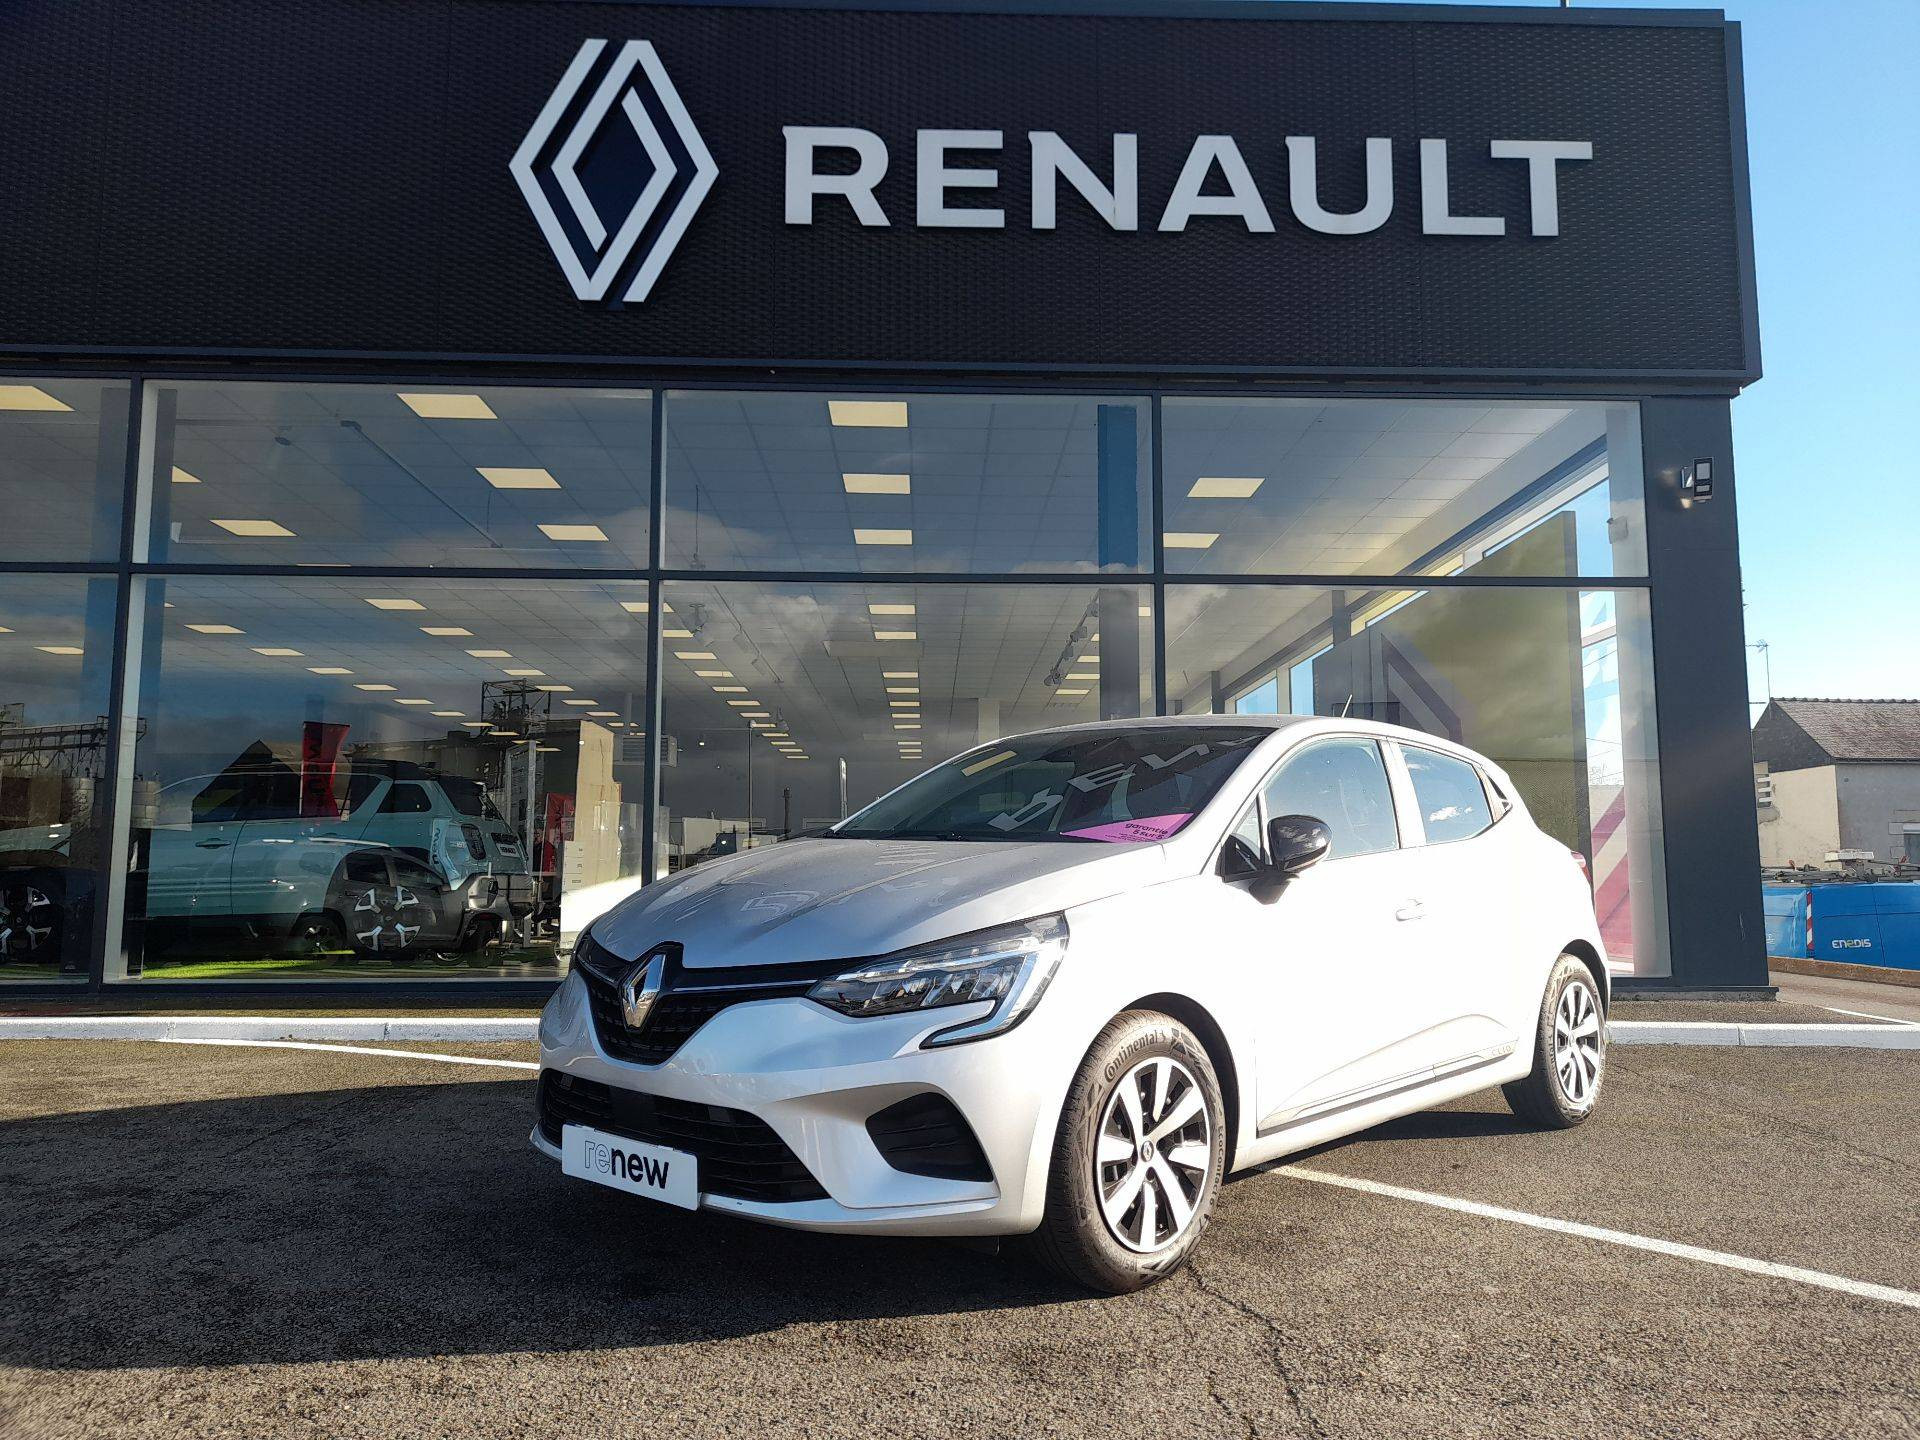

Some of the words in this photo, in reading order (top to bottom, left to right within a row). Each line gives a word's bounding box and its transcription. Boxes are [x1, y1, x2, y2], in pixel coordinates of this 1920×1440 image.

[782, 126, 1593, 236] RENAULT
[1125, 822, 1169, 835] garantie
[1139, 830, 1155, 838] sur
[1104, 1029, 1158, 1083] Continental
[584, 1140, 669, 1189] renew
